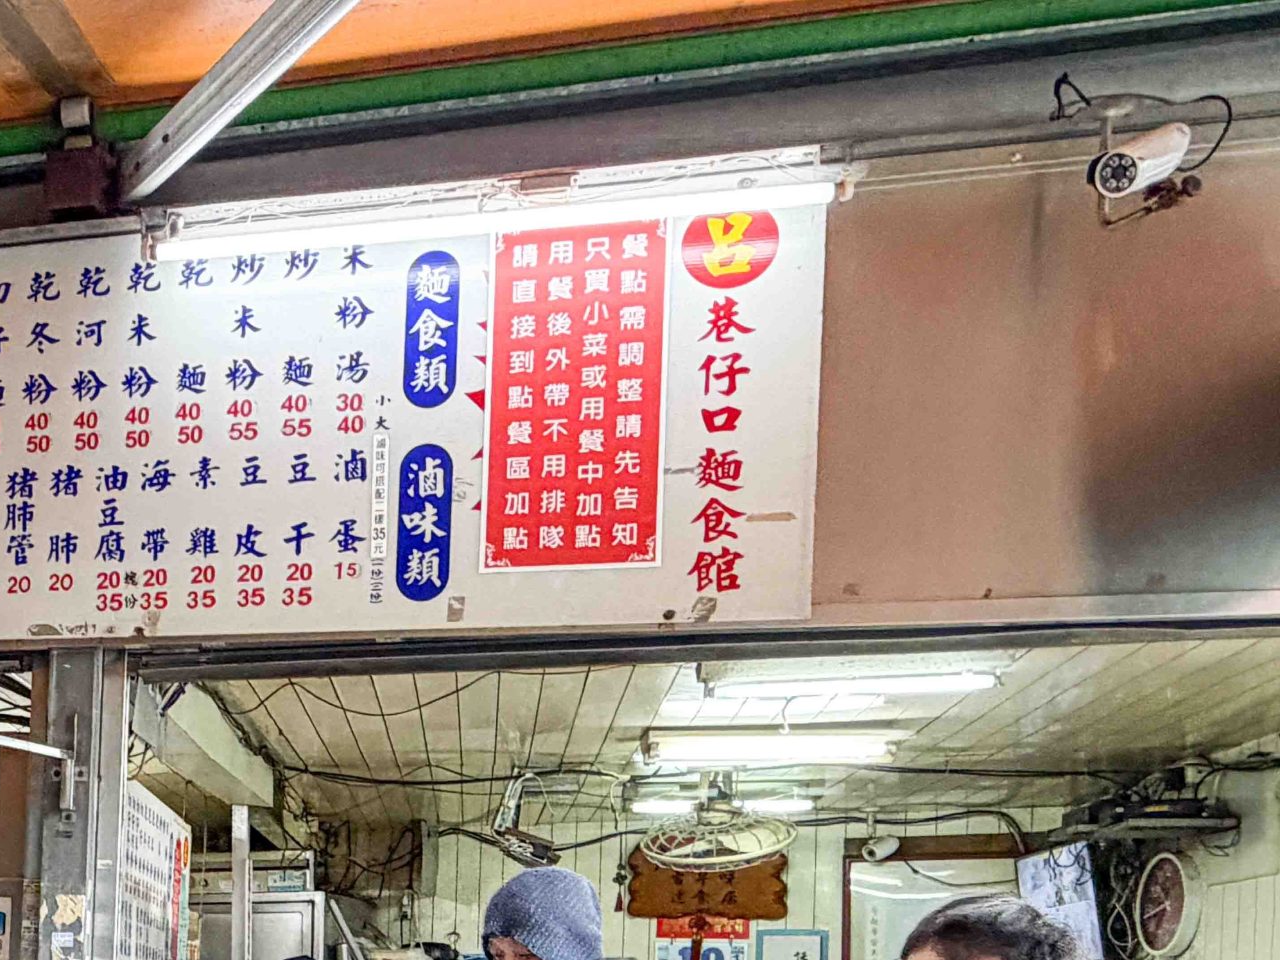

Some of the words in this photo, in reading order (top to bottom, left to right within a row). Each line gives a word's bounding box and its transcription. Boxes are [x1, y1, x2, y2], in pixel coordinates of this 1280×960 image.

[701, 212, 757, 278] 呂
[225, 254, 265, 391] 炒米粉
[283, 249, 320, 387] 炒麵
[335, 245, 374, 383] 米粉湯
[71, 266, 110, 402] 乾河粉
[121, 262, 161, 398] 乾米粉
[176, 259, 213, 394] 乾麵
[407, 263, 454, 394] 麵食類
[22, 271, 60, 405] 乾冬粉
[375, 395, 391, 407] 小
[502, 243, 538, 550] 請直接到點餐區加點
[538, 240, 574, 549] 用餐後外帶不用排隊
[575, 237, 611, 548] 只買小菜或用餐中加點
[611, 234, 648, 546] 餐點需調整請先告知
[176, 402, 202, 421] 40
[226, 400, 252, 418] 40
[281, 395, 308, 413] 40
[336, 394, 364, 413] 30
[24, 413, 50, 432] 40
[73, 411, 99, 430] 40
[124, 407, 151, 427] 40
[336, 415, 365, 435] 40
[375, 416, 391, 431] 大
[124, 429, 152, 449] 50
[177, 425, 205, 445] 50
[229, 421, 260, 442] 55
[282, 418, 312, 440] 55
[26, 434, 52, 455] 50
[74, 431, 101, 452] 50
[687, 296, 757, 594] 巷仔口麵食館
[141, 459, 176, 561] 海帶
[185, 456, 220, 558] 素雞
[234, 456, 267, 557] 豆皮
[283, 453, 317, 556] 豆干
[329, 449, 367, 553] 滷蛋
[94, 465, 128, 563] 油豆腐
[399, 457, 447, 588] 滷味類
[96, 571, 122, 591] 20
[143, 567, 169, 589] 20
[191, 565, 217, 586] 20
[237, 563, 264, 584] 20
[286, 562, 313, 583] 20
[335, 562, 357, 580] 15
[7, 575, 32, 597] 20
[48, 572, 75, 593] 20
[96, 593, 123, 613] 35
[139, 591, 169, 612] 35
[186, 589, 217, 611] 35
[238, 587, 266, 608] 35
[282, 586, 314, 608] 35
